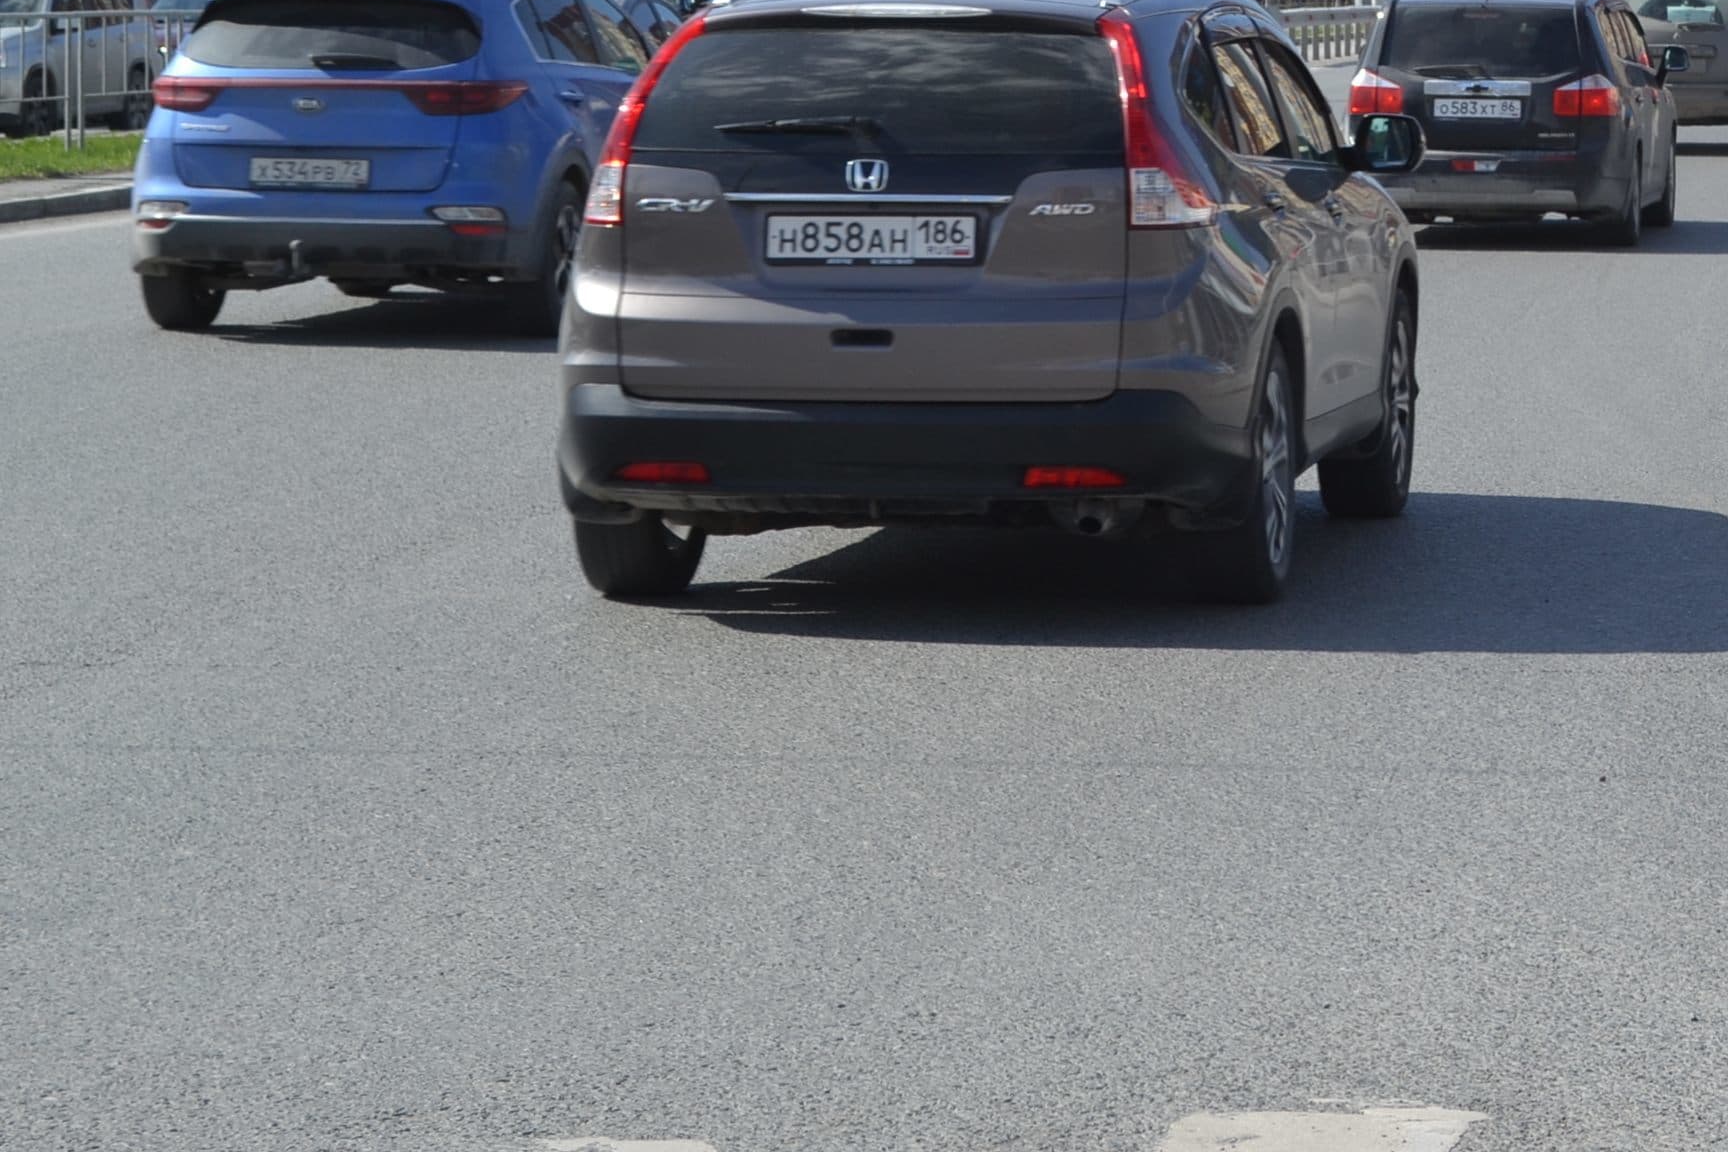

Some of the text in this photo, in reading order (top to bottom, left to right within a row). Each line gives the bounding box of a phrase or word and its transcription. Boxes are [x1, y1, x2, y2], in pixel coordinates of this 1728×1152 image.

[1500, 100, 1516, 113] 86
[342, 160, 362, 178] 72
[917, 219, 966, 245] 186
